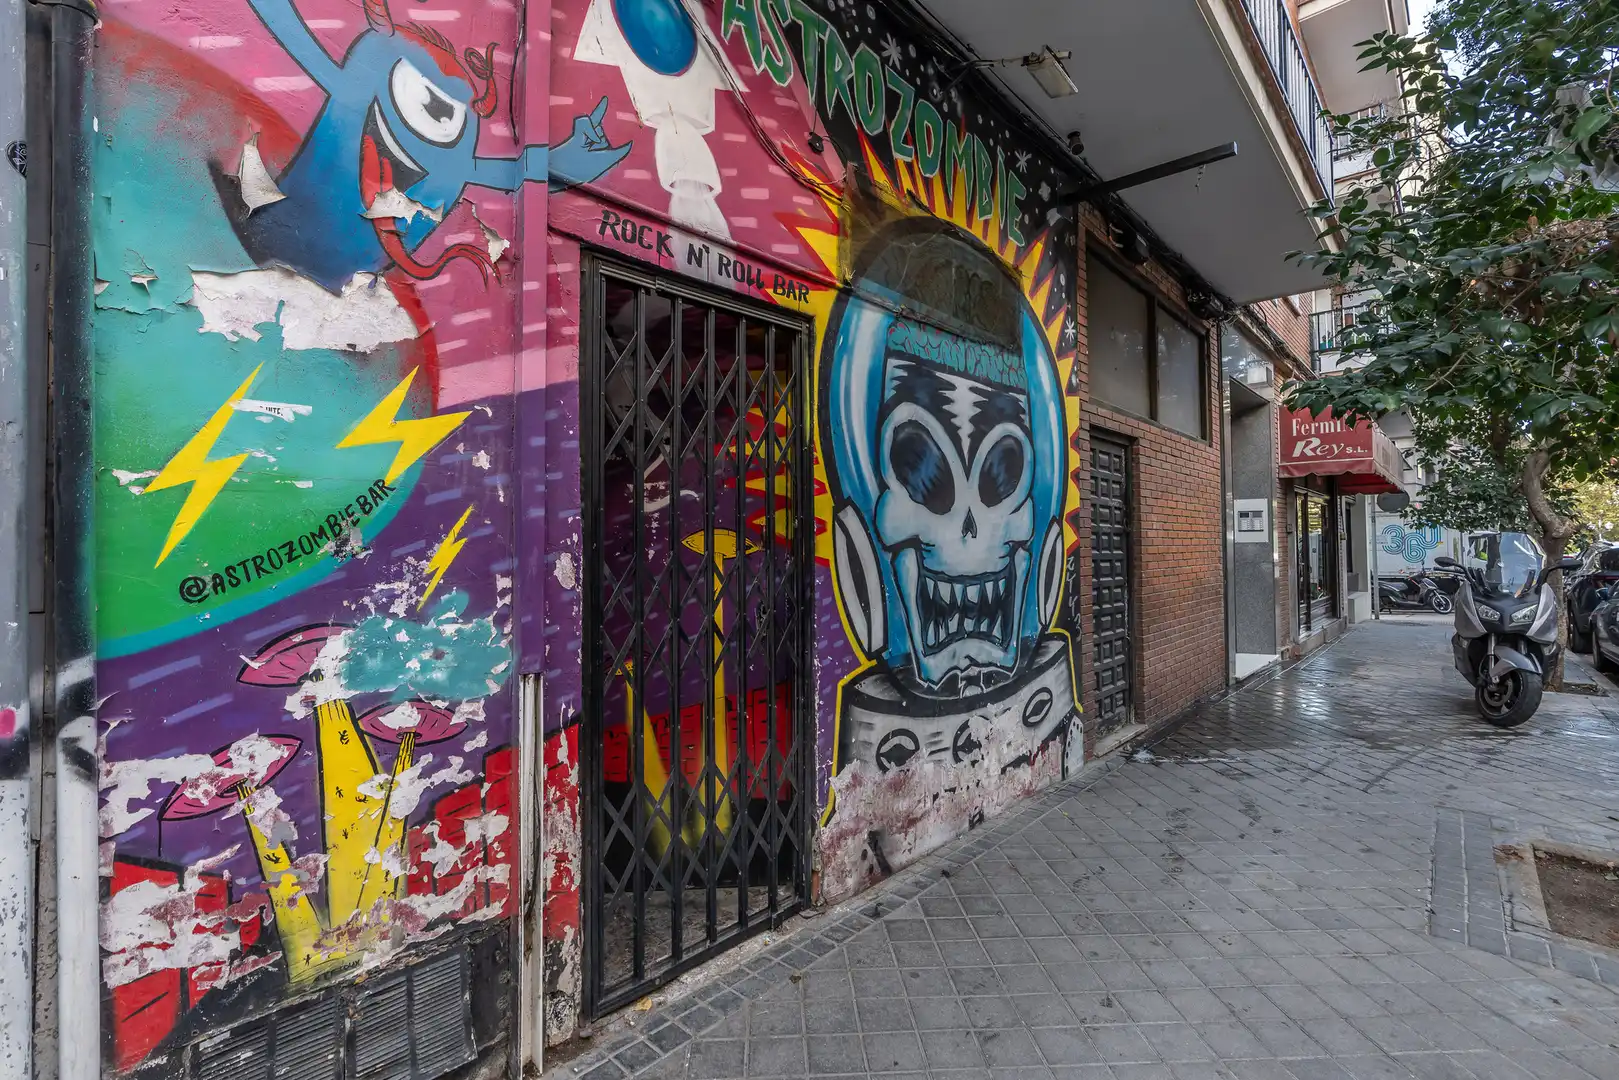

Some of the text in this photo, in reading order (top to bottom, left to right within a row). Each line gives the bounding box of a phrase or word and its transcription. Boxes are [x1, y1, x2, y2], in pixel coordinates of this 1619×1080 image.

[721, 0, 1027, 248] ASTROZOMBIE
[598, 209, 675, 259] ROCK
[717, 252, 765, 291] ROLL
[773, 273, 811, 305] BAR
[1292, 437, 1345, 459] Rey
